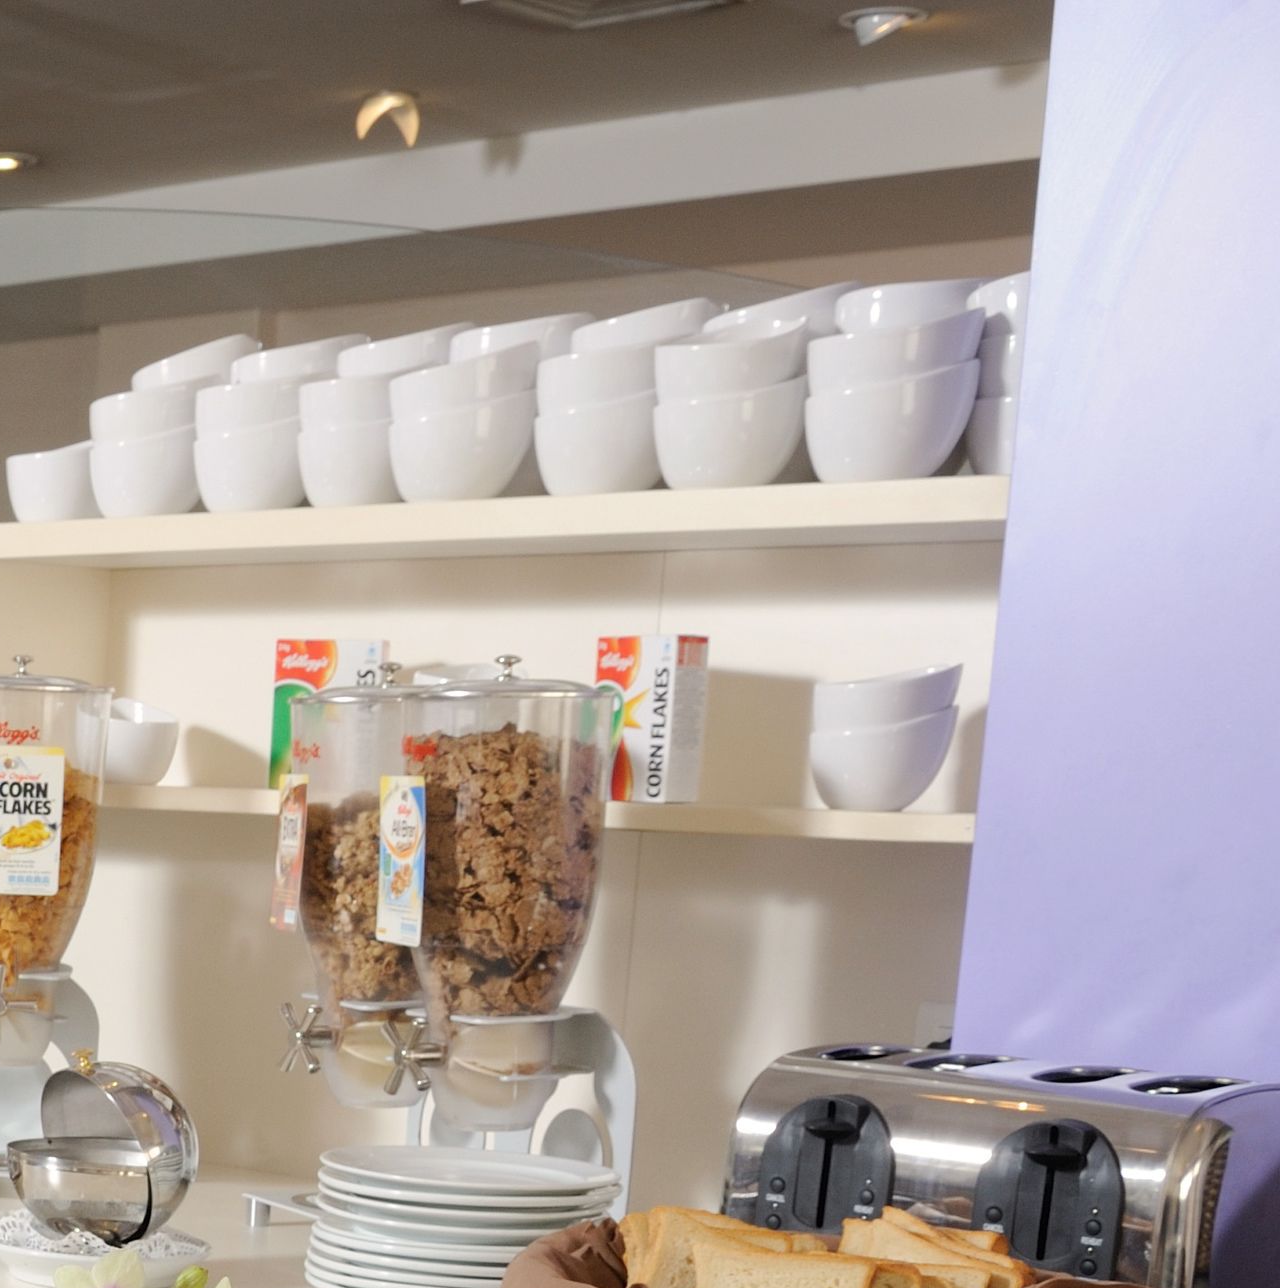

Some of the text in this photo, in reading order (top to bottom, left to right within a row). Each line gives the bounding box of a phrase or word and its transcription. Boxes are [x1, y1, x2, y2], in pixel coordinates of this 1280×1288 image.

[650, 667, 670, 738] FLAKES
[0, 782, 48, 798] CORN
[646, 744, 664, 798] CORN
